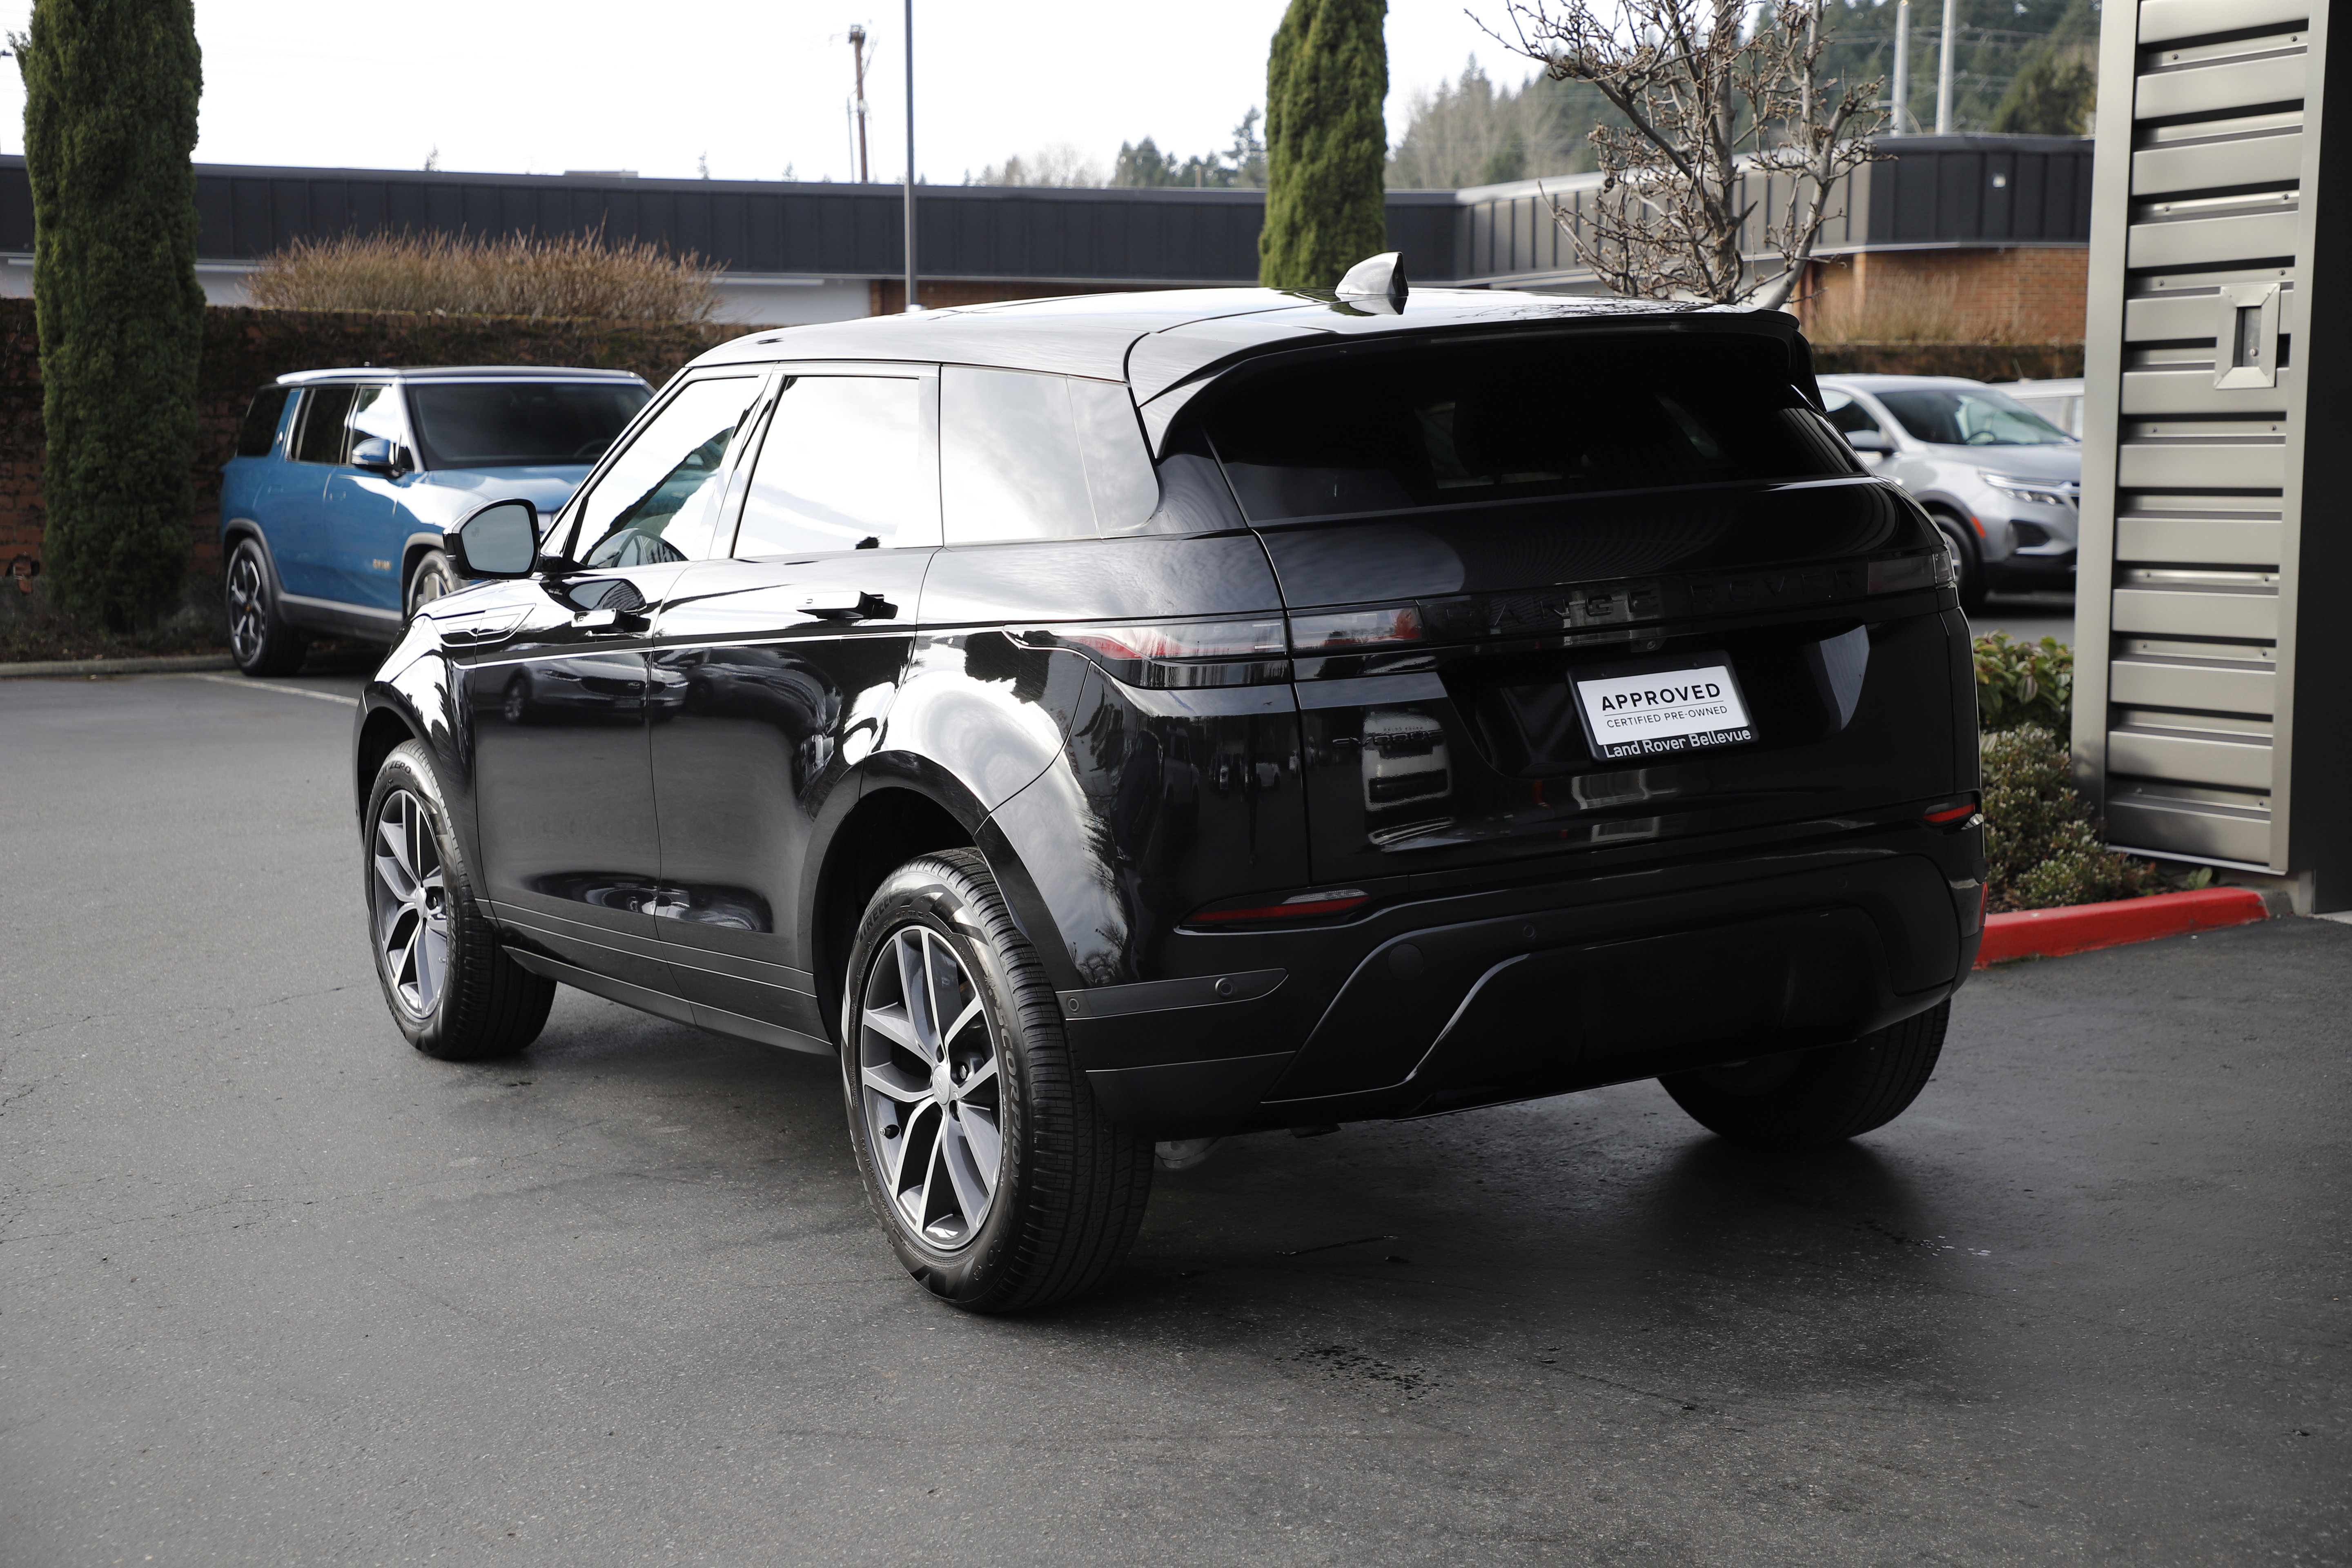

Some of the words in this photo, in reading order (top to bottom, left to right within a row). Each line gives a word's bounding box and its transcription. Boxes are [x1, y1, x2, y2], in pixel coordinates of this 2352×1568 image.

[1446, 590, 1659, 627] RANGE
[1690, 569, 1853, 604] ROVER
[1602, 683, 1720, 711] APPROVED
[1607, 714, 1661, 728] CERTIFIED
[1664, 706, 1727, 720] PRE-OWNED
[1604, 742, 1641, 758] Land
[1642, 737, 1686, 753] Rover
[1688, 729, 1751, 747] Bellevue
[390, 761, 411, 773] ZERO
[448, 891, 456, 964] 235/55
[994, 1006, 1021, 1188] SCORPION
[987, 1193, 1014, 1266] ZERO
